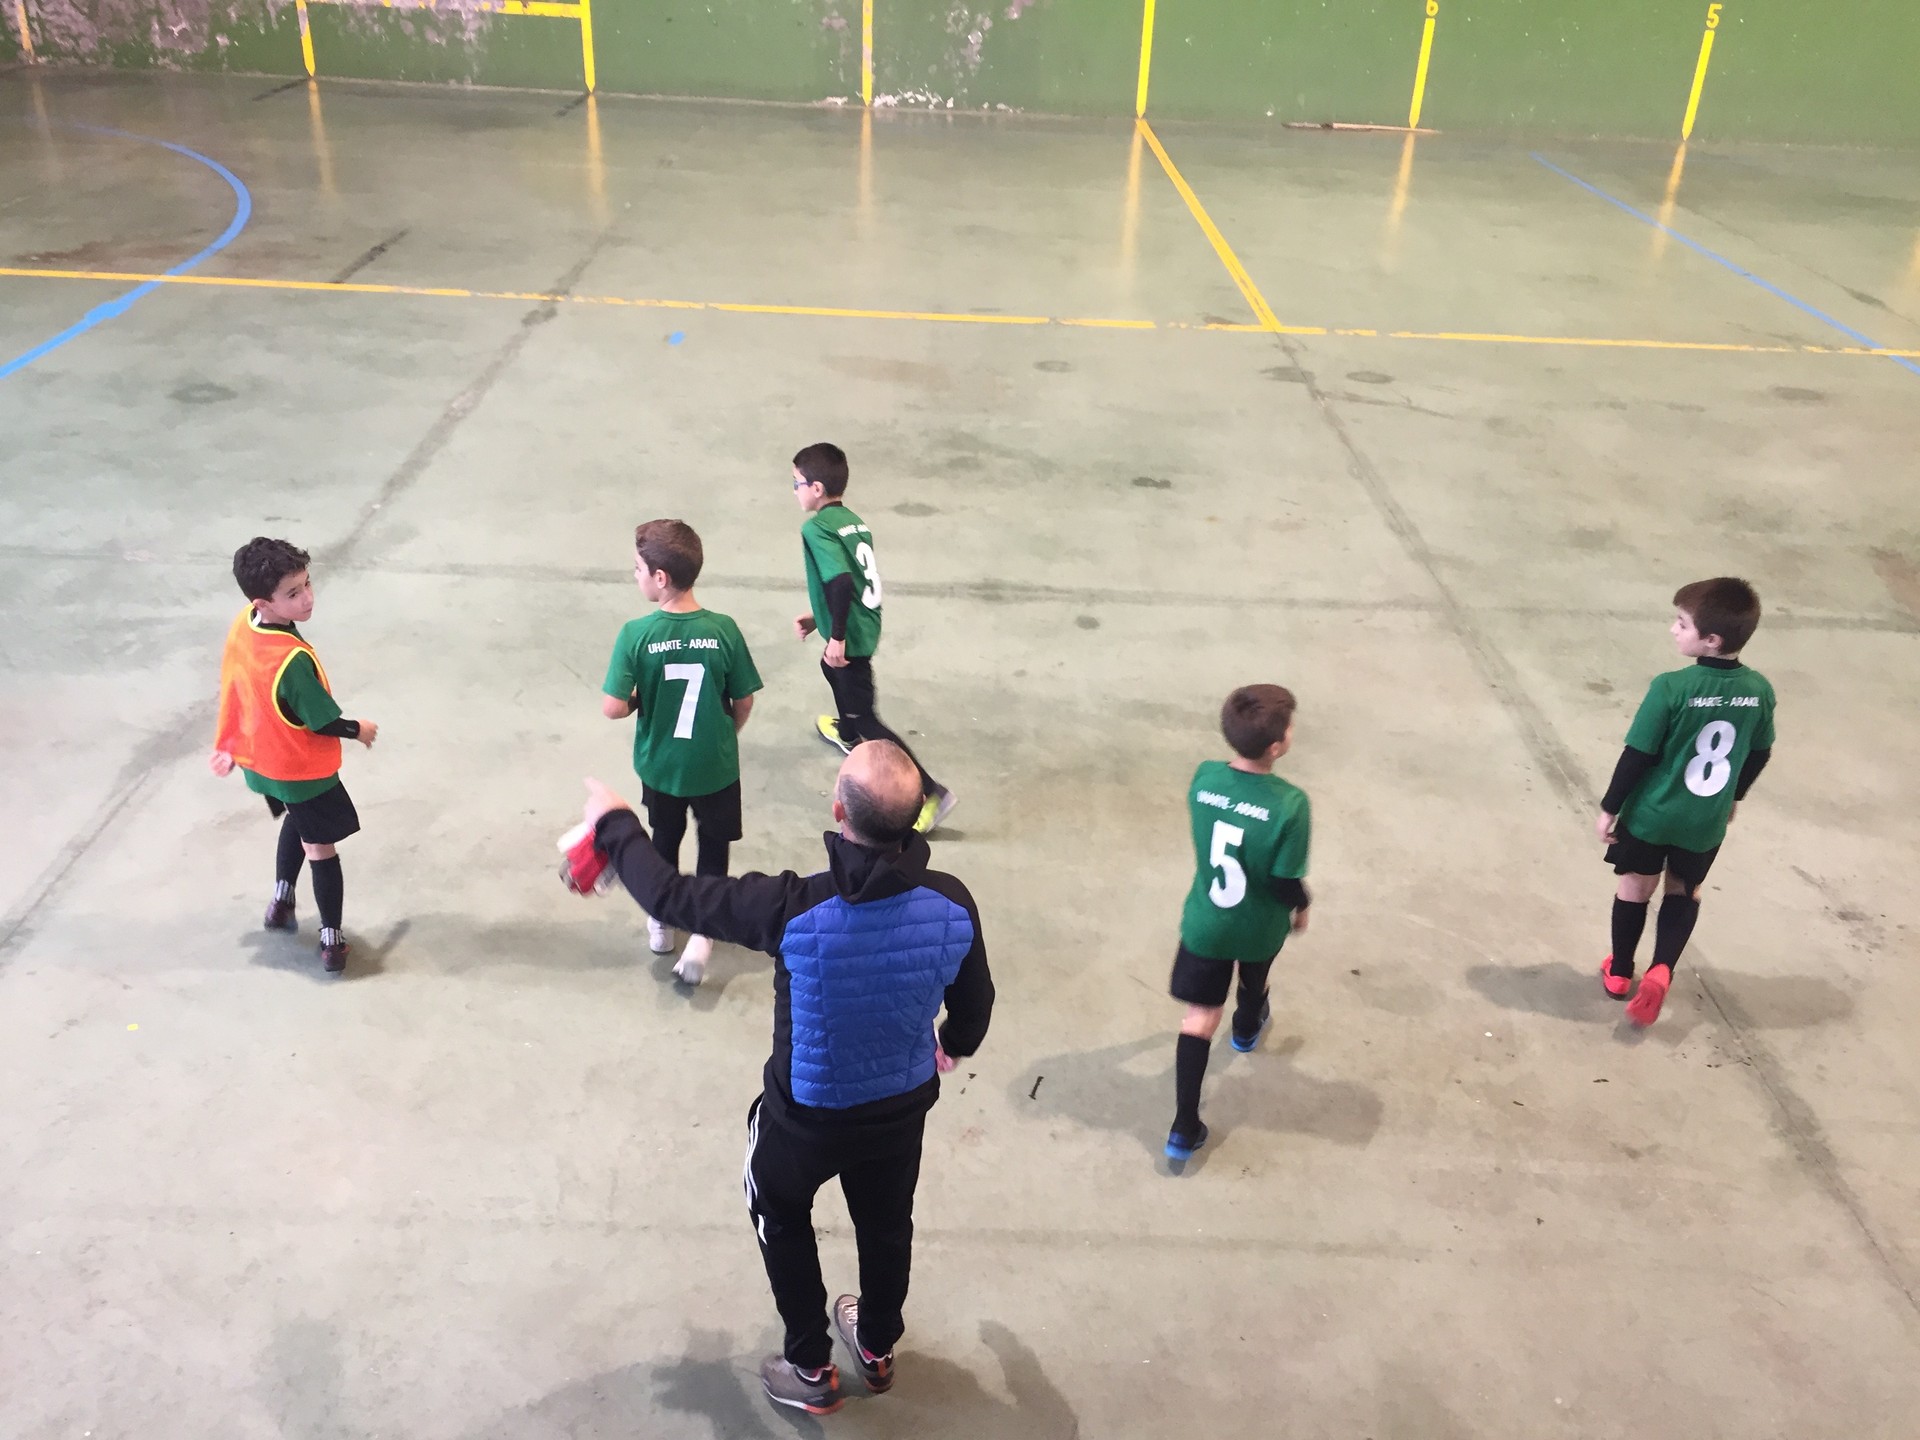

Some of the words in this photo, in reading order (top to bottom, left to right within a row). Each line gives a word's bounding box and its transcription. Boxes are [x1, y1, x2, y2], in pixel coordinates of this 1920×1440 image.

[1705, 3, 1723, 29] 5
[855, 541, 882, 610] 3
[648, 639, 682, 654] UHARTE
[664, 663, 706, 740] 7
[1684, 720, 1737, 797] 8
[1208, 819, 1247, 909] 5
